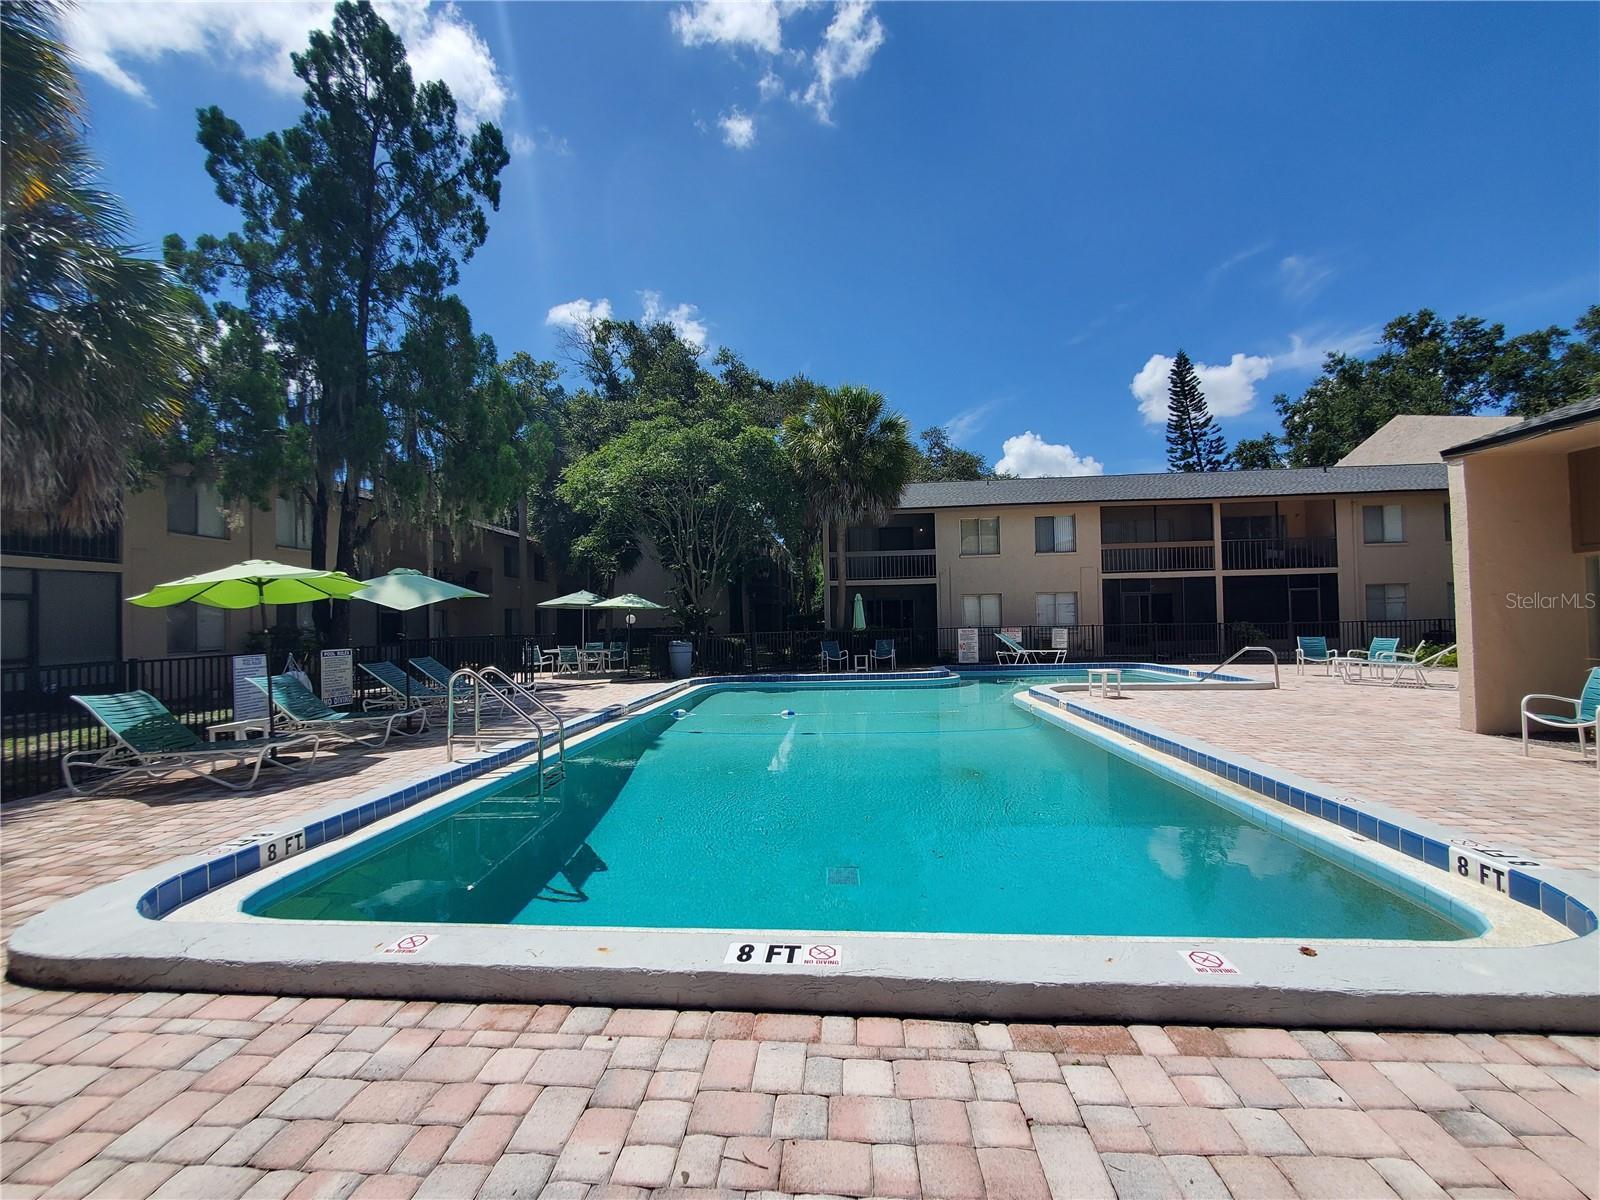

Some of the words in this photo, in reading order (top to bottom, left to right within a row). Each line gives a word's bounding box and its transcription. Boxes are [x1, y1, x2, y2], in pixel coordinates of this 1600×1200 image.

[333, 696, 351, 705] DIVING
[267, 843, 277, 861] 8
[1457, 856, 1469, 877] 8
[736, 944, 755, 962] 8
[765, 945, 802, 964] FT
